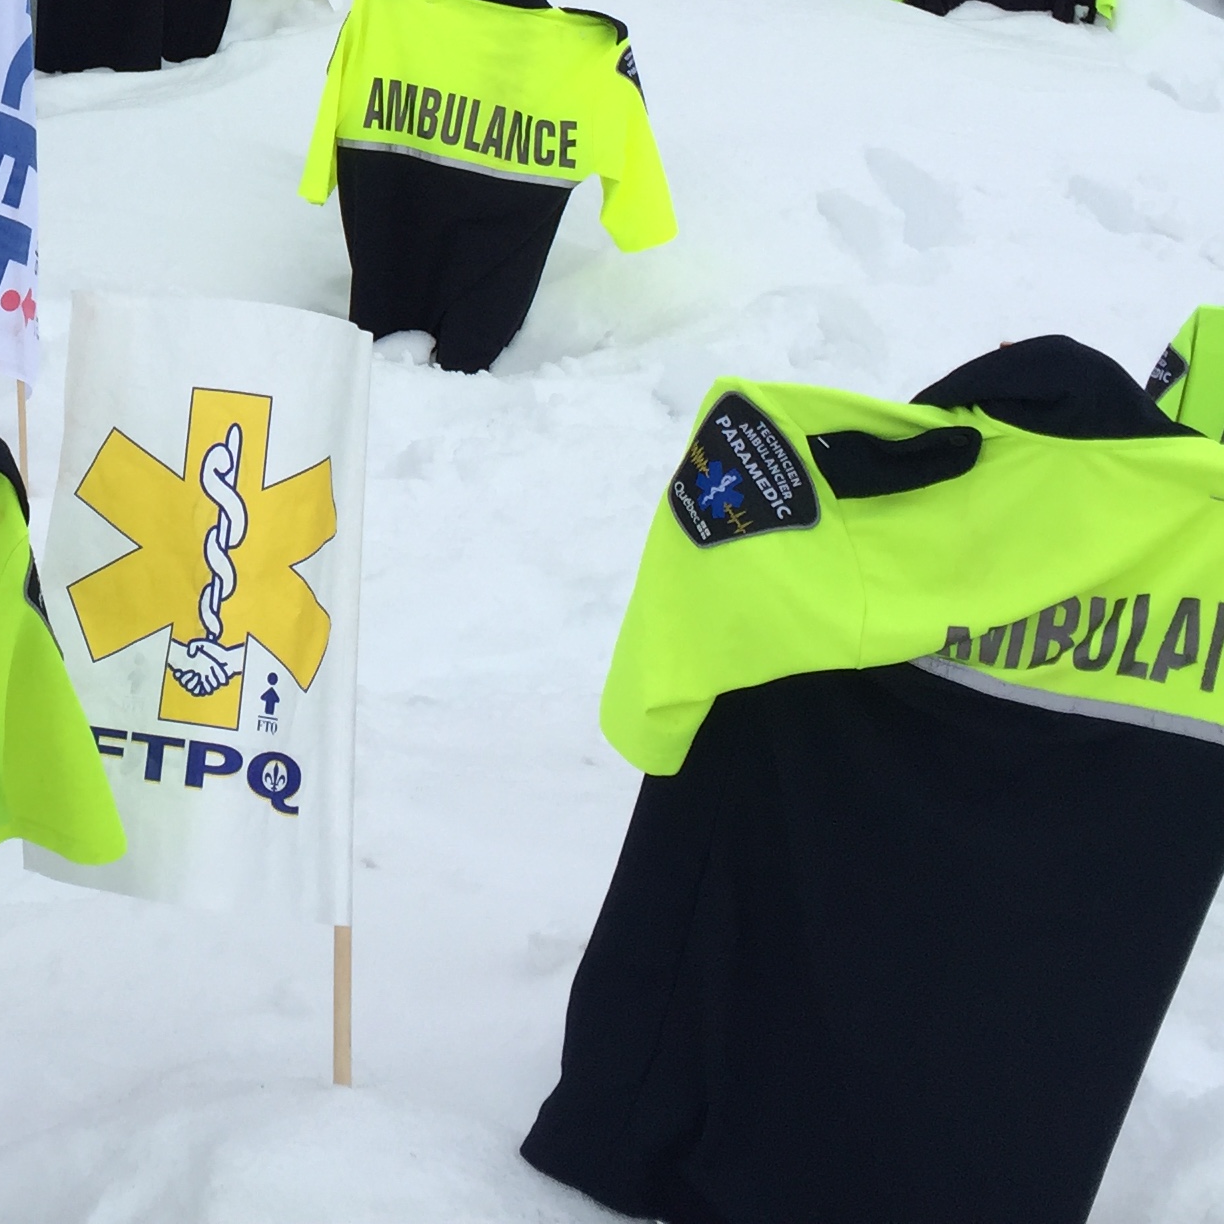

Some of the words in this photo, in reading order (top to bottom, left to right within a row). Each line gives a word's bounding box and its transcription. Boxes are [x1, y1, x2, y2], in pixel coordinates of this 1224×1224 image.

[362, 76, 577, 170] AMBULANCE
[715, 415, 792, 520] PARAMEDIC
[739, 422, 794, 500] AMBULANCIER
[756, 420, 802, 488] TECHNICIEN
[674, 481, 700, 524] Québec
[90, 725, 302, 816] FTPQ
